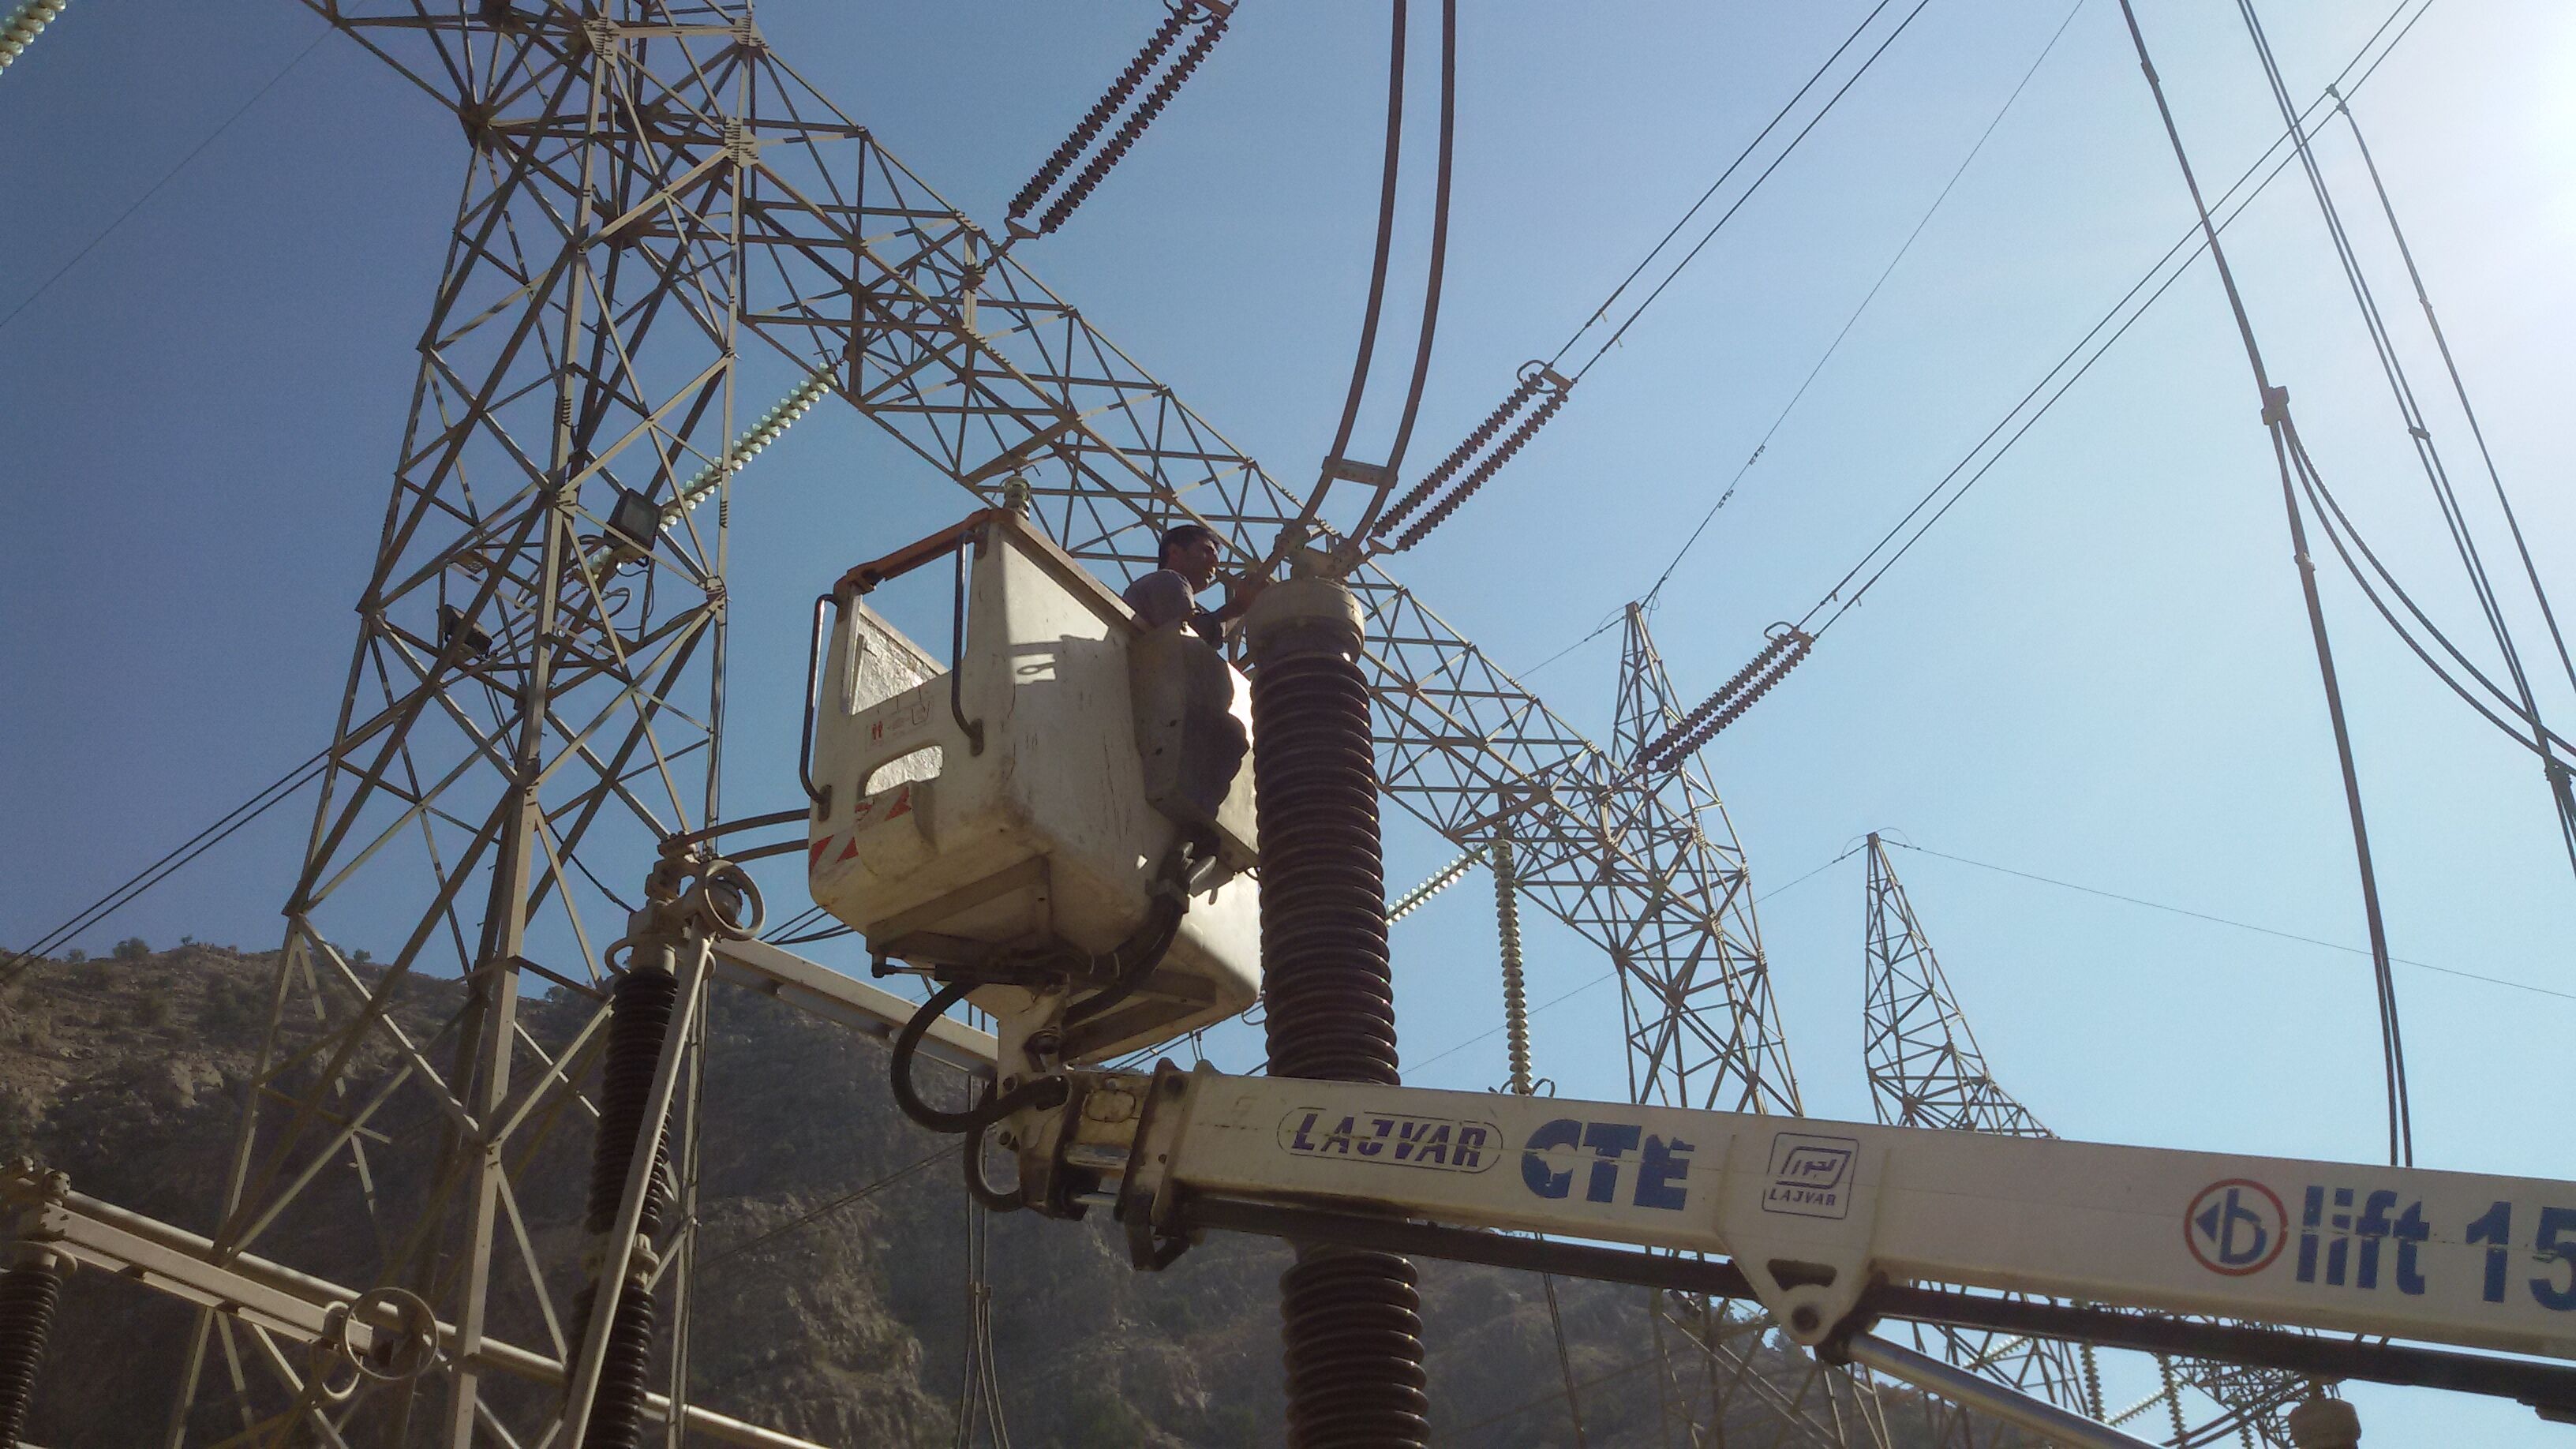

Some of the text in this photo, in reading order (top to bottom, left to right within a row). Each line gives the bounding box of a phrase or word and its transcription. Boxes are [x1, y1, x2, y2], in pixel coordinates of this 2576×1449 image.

[1291, 1114, 1487, 1167] LAJVAR
[1521, 1119, 1695, 1211] CTE
[1769, 1188, 1837, 1206] LAJVAR
[2297, 1186, 2430, 1295] lift
[2466, 1201, 2576, 1312] 15
